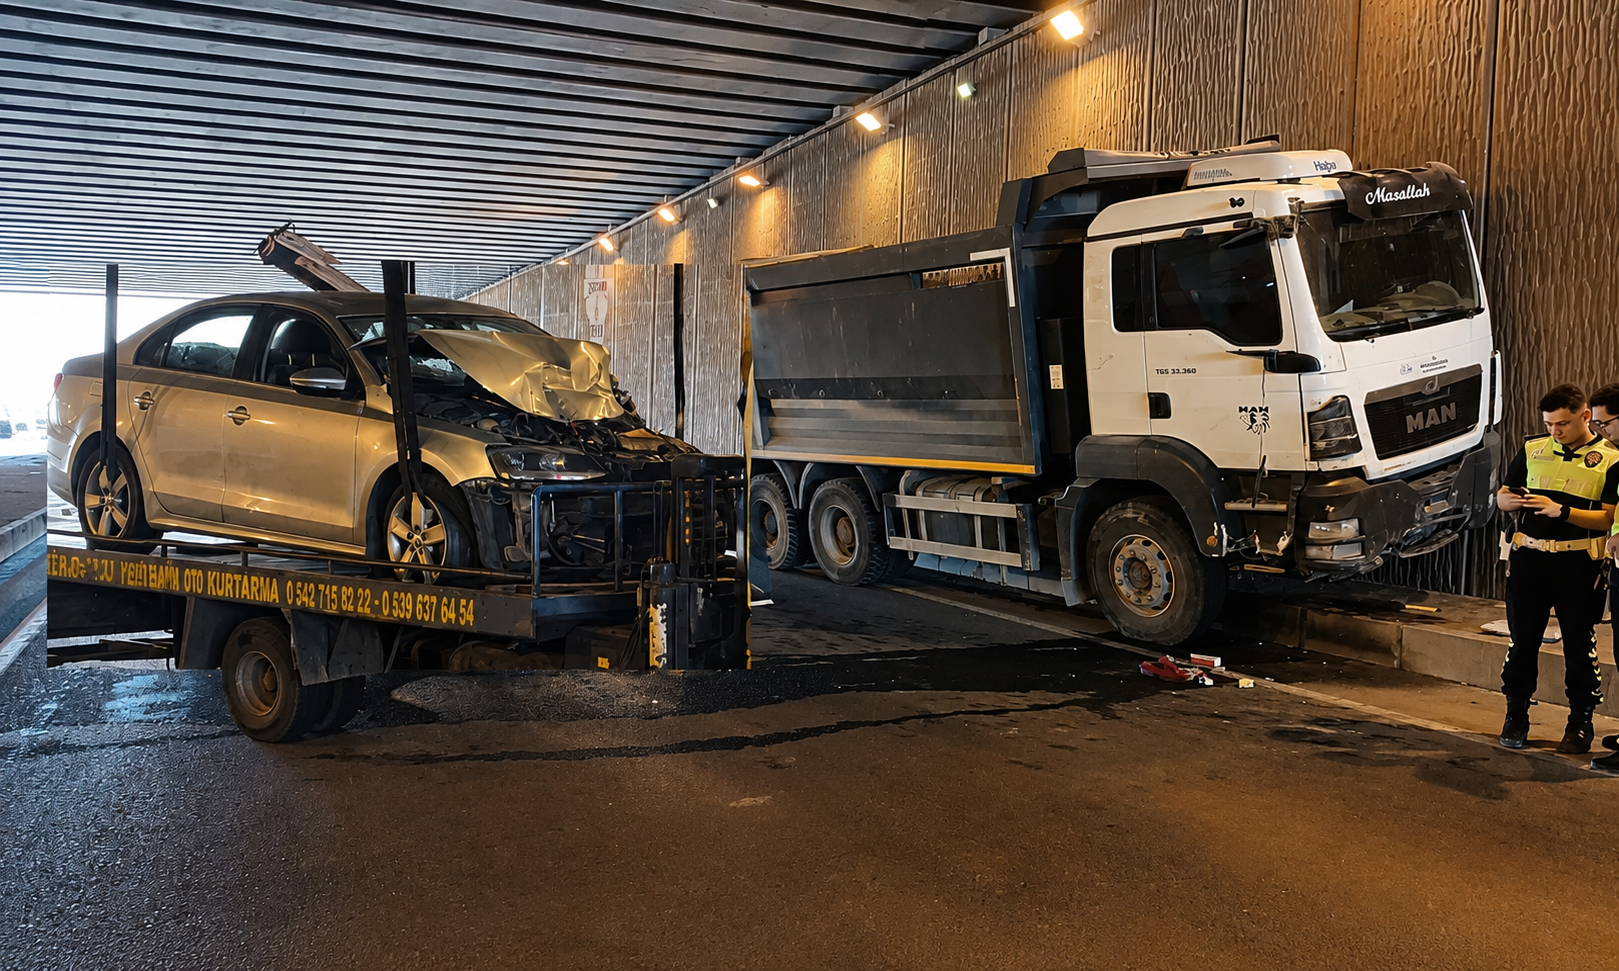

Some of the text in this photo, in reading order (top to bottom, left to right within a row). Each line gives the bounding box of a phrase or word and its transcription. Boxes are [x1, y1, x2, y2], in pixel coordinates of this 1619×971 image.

[1405, 401, 1457, 434] MAN
[184, 568, 204, 594] OTO
[207, 570, 280, 604] KURTARMA
[286, 580, 294, 605] 0
[296, 581, 316, 608] 542
[318, 584, 338, 611] 715
[341, 586, 354, 612] 82
[357, 588, 371, 614] 22
[382, 590, 390, 616] 0
[392, 591, 413, 619] 539
[416, 594, 437, 622] 637
[441, 597, 456, 624] 64
[459, 598, 475, 627] 54
